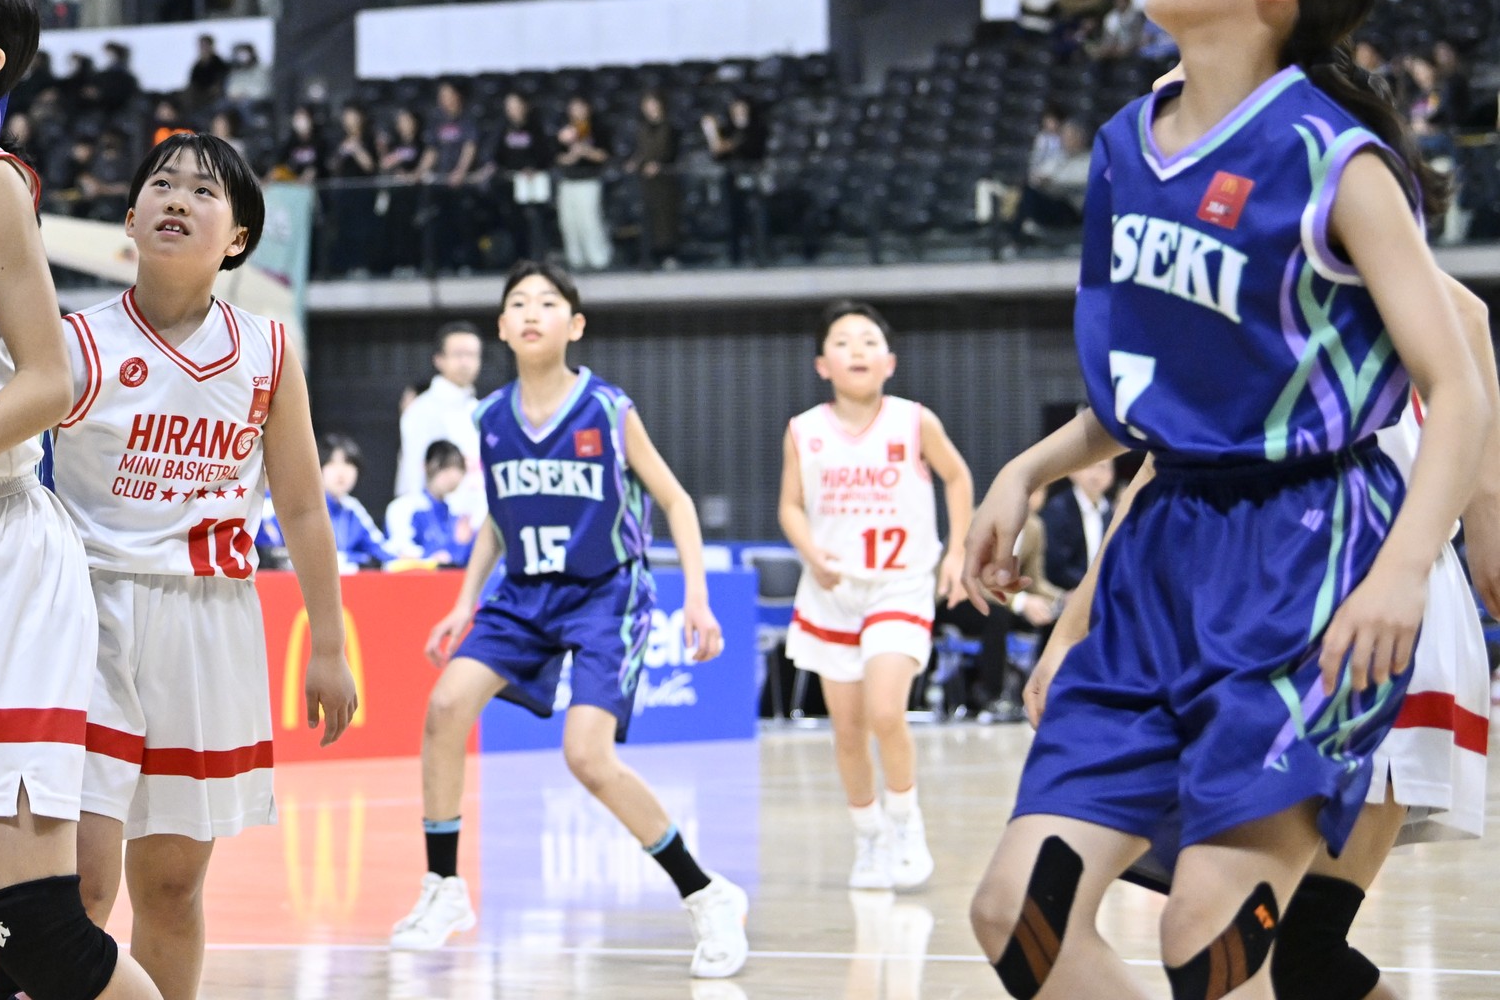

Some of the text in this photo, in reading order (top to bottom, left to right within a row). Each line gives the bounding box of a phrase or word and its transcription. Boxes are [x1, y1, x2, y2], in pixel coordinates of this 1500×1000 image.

[1108, 350, 1156, 440] 7
[126, 413, 260, 461] HIRANO
[118, 453, 161, 477] MINI
[820, 466, 901, 489] HIRANO
[111, 476, 158, 501] CLUB
[519, 525, 571, 575] 15
[861, 527, 907, 570] 12
